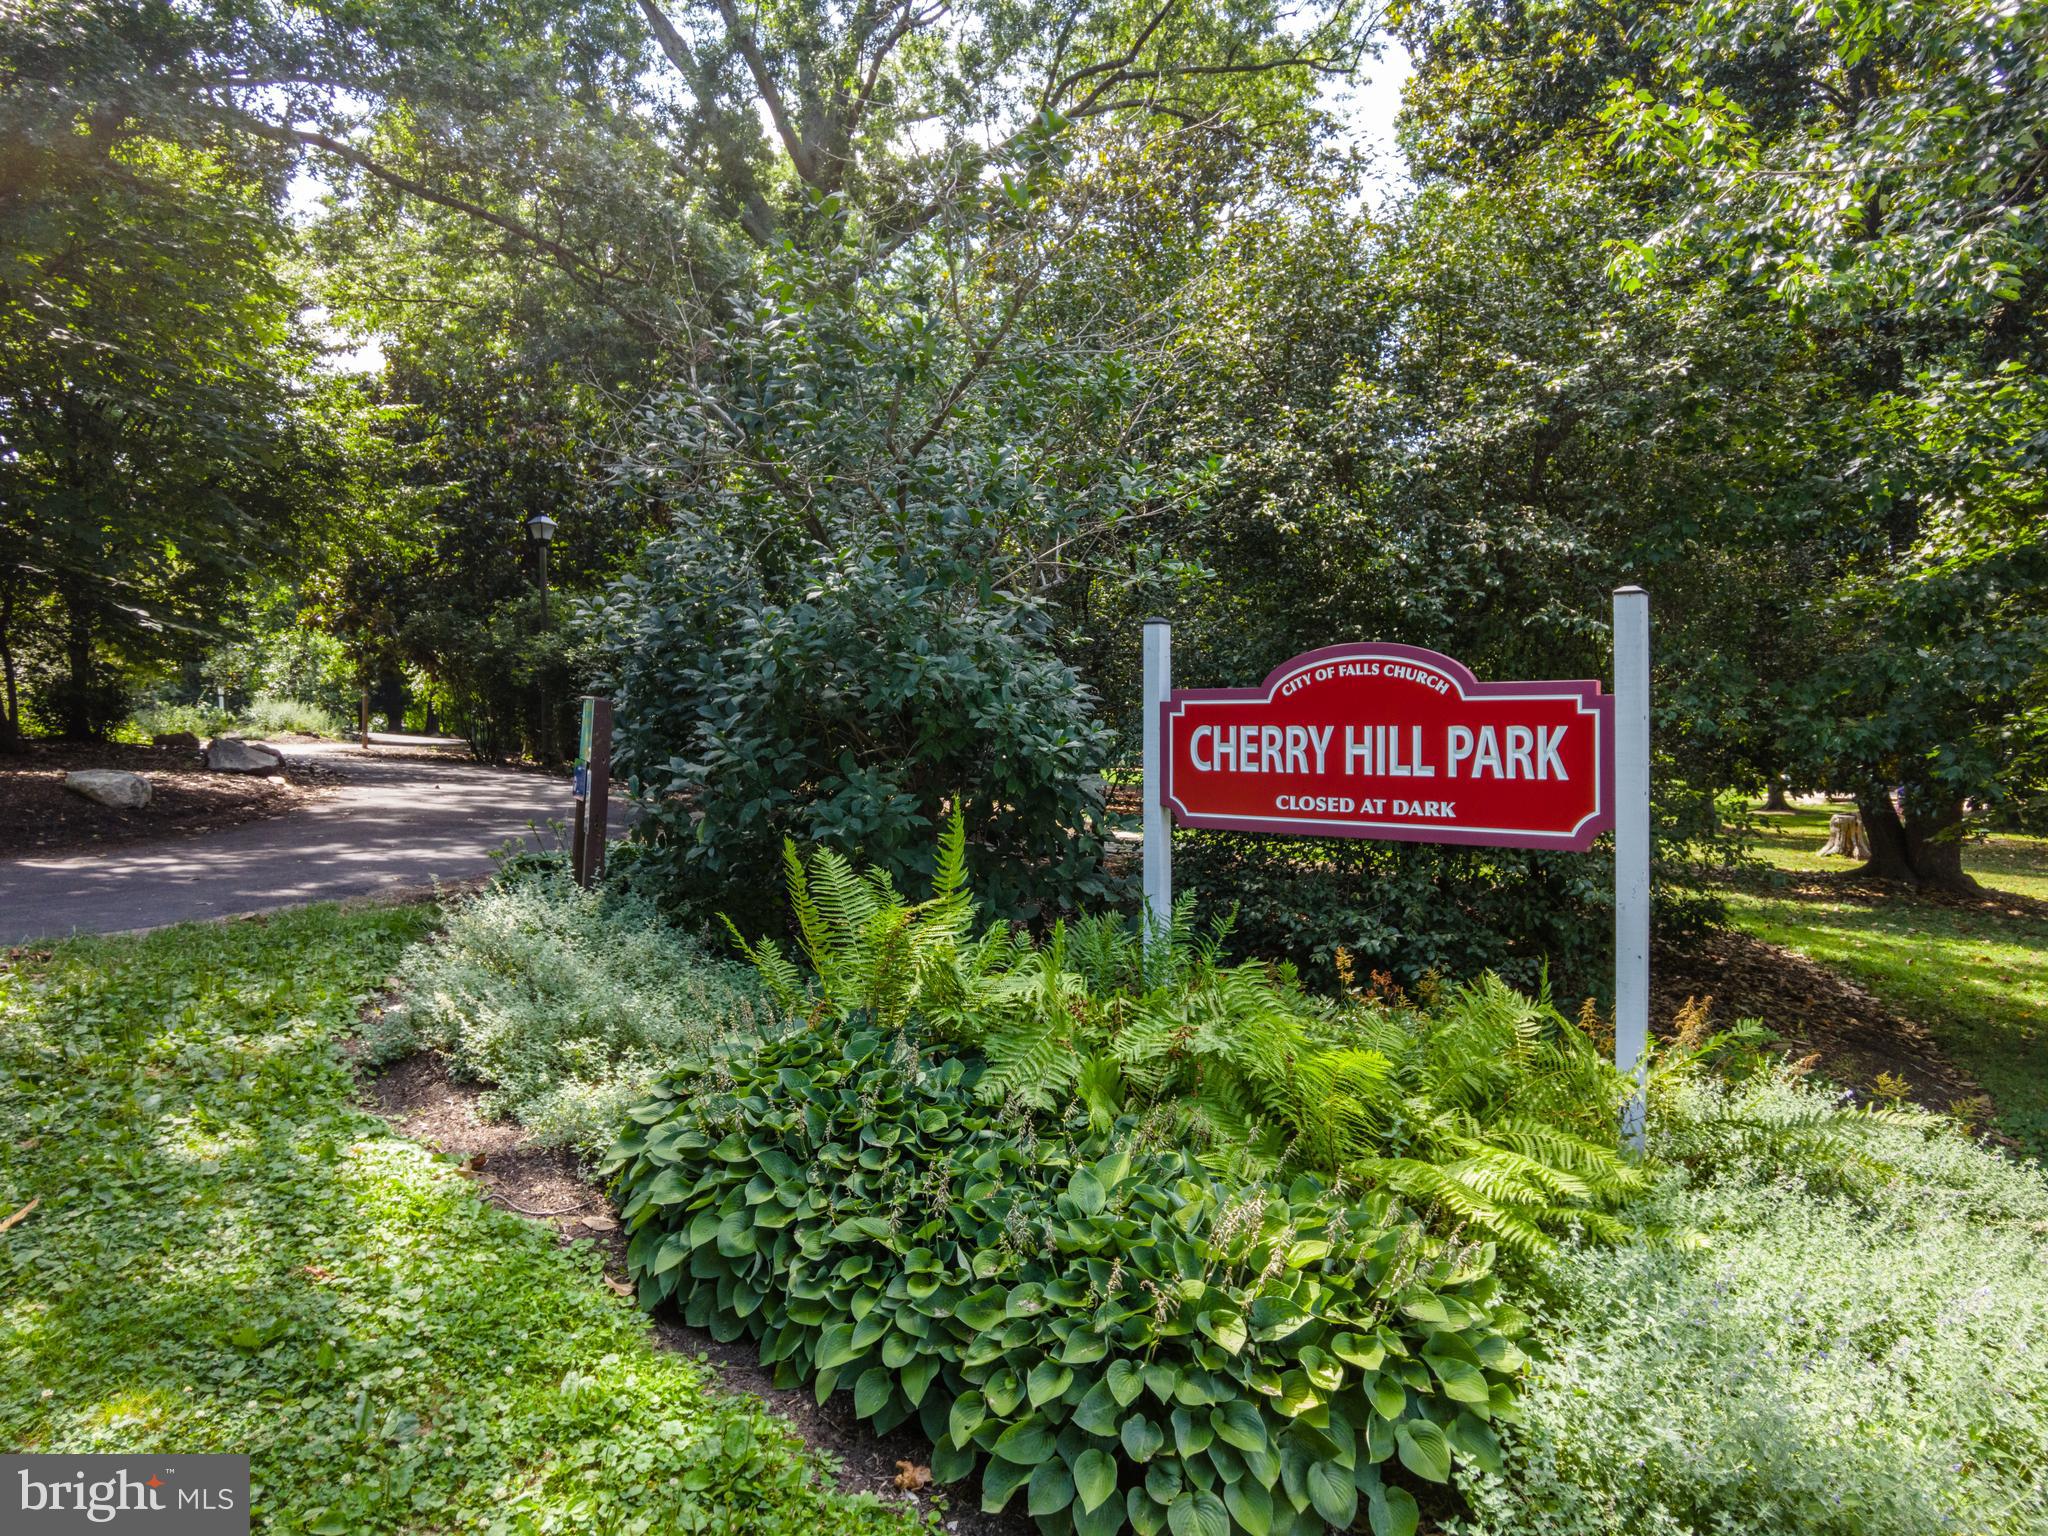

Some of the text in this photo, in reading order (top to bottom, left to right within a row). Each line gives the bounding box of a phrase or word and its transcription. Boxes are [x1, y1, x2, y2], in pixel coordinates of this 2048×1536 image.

[1281, 662, 1451, 697] CITY OF FALLS CHURCH
[1190, 725, 1570, 781] CHERRY HILL PARK
[1275, 795, 1457, 818] CLOSED AT DARK
